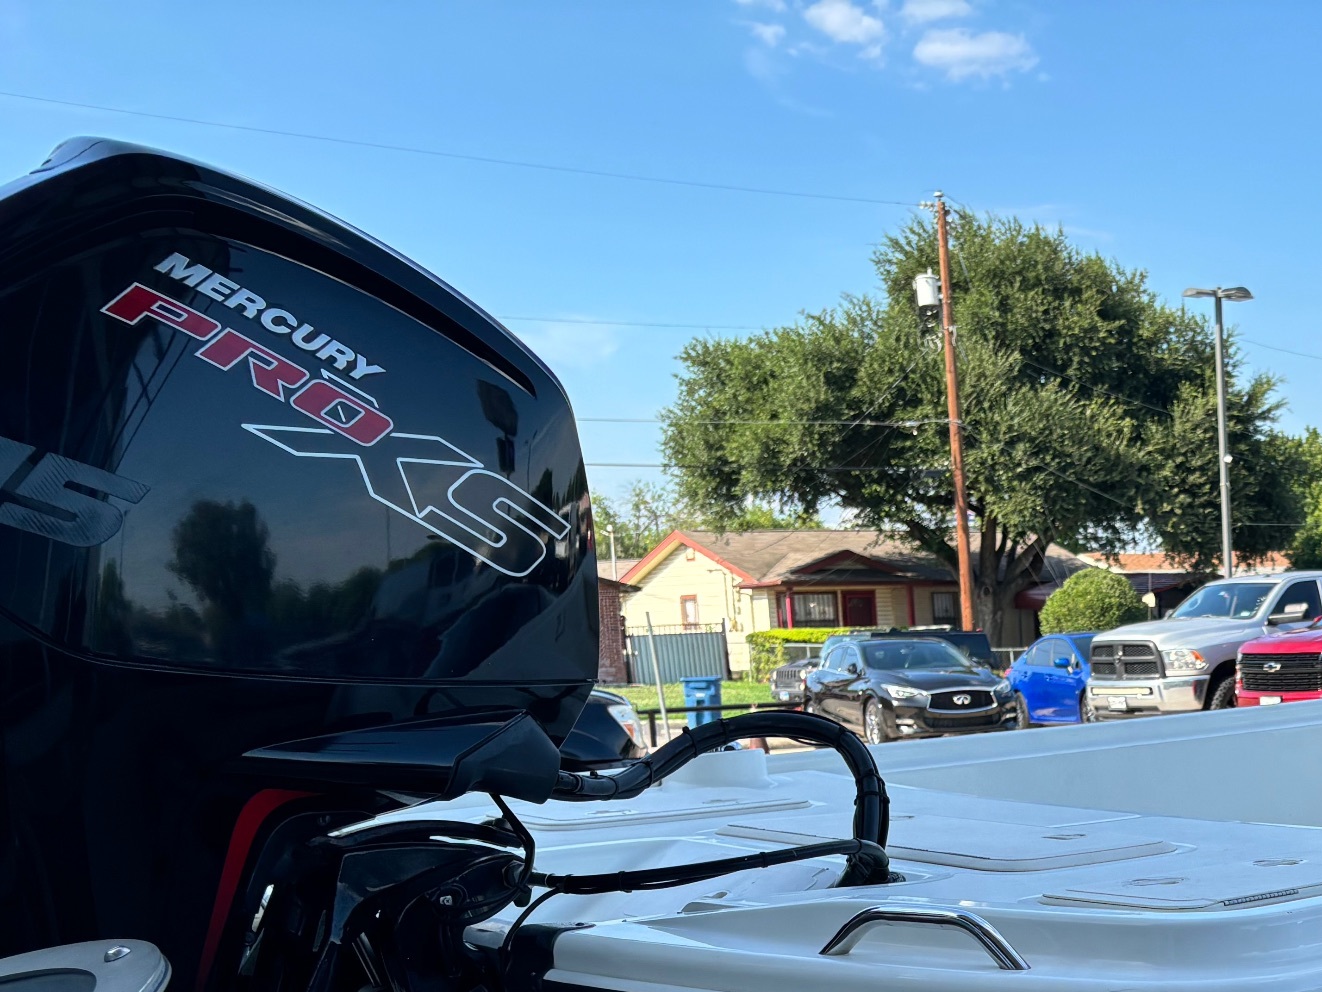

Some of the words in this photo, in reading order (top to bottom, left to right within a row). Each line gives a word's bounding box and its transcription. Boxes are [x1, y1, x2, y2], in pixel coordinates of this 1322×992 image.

[100, 282, 394, 447] PRO
[153, 252, 386, 380] MERCURY
[241, 369, 571, 577] XS
